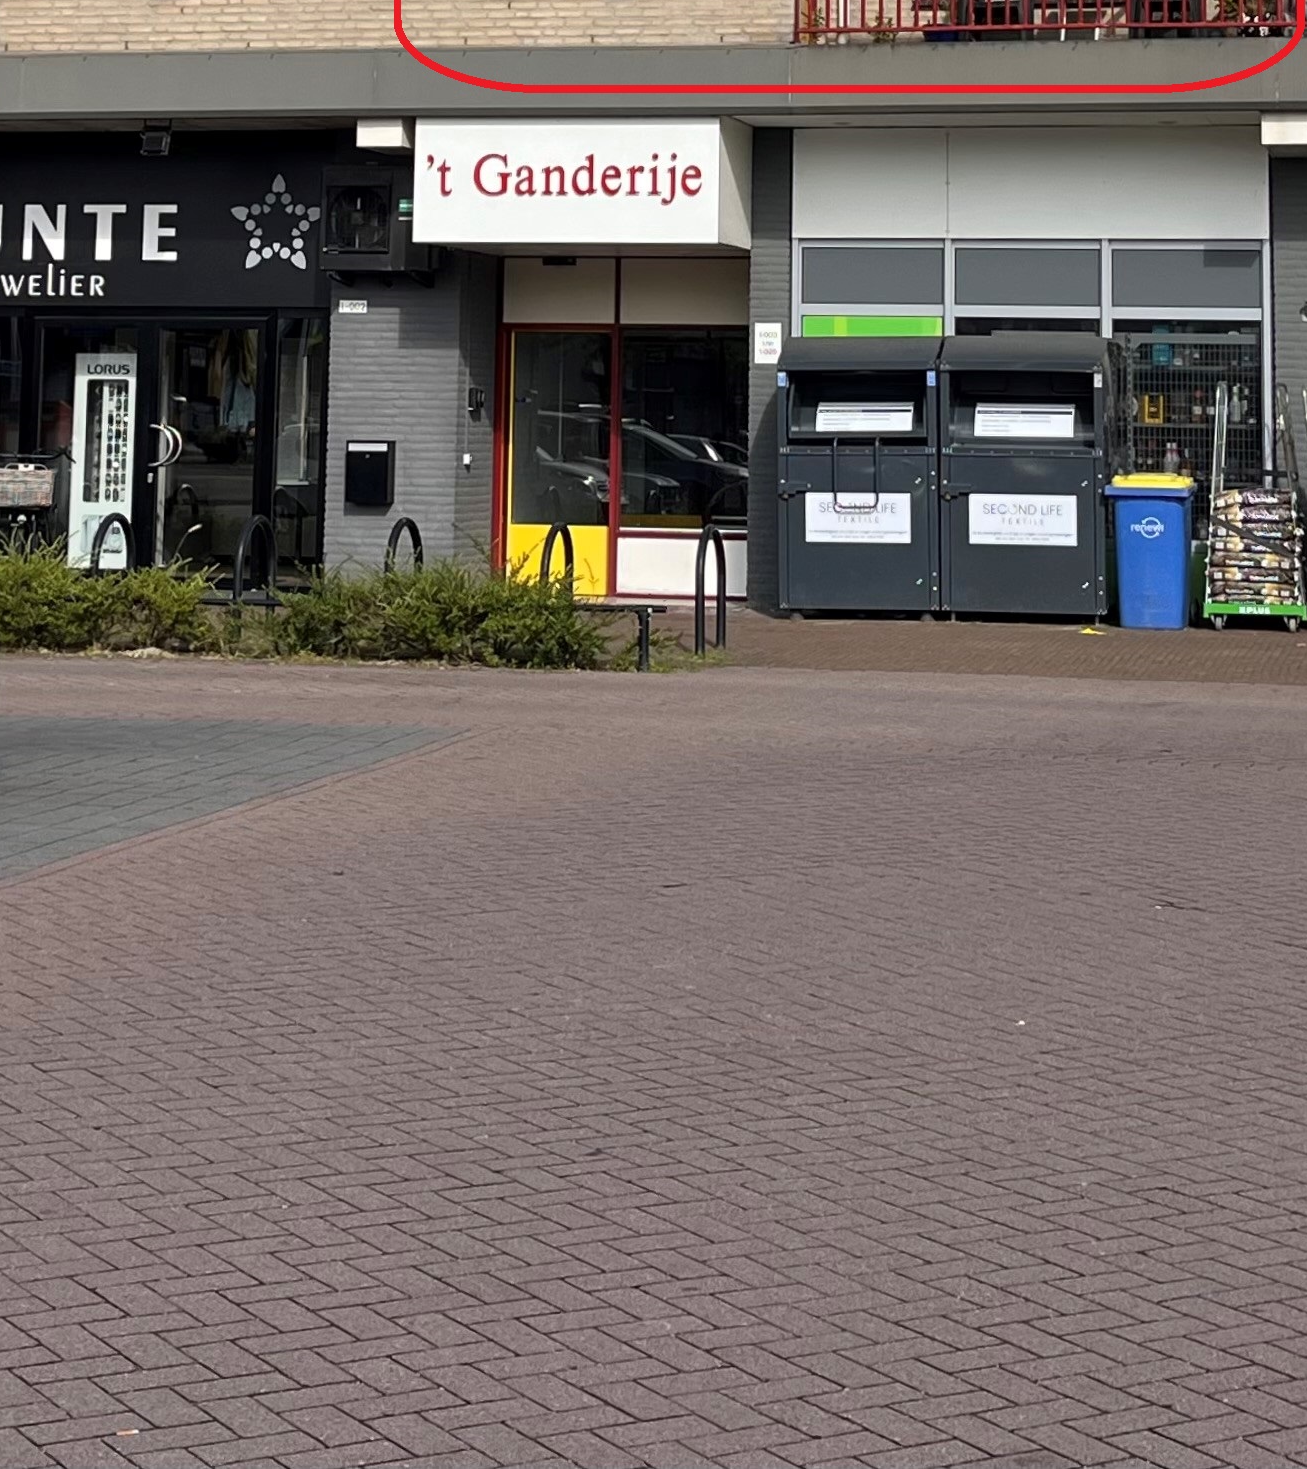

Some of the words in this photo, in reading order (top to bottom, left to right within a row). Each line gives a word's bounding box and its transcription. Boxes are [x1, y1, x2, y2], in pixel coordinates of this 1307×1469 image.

[472, 152, 703, 206] Ganderije
[86, 363, 131, 376] LORUS
[982, 503, 1038, 515] SECOND
[1040, 504, 1063, 516] LIFE
